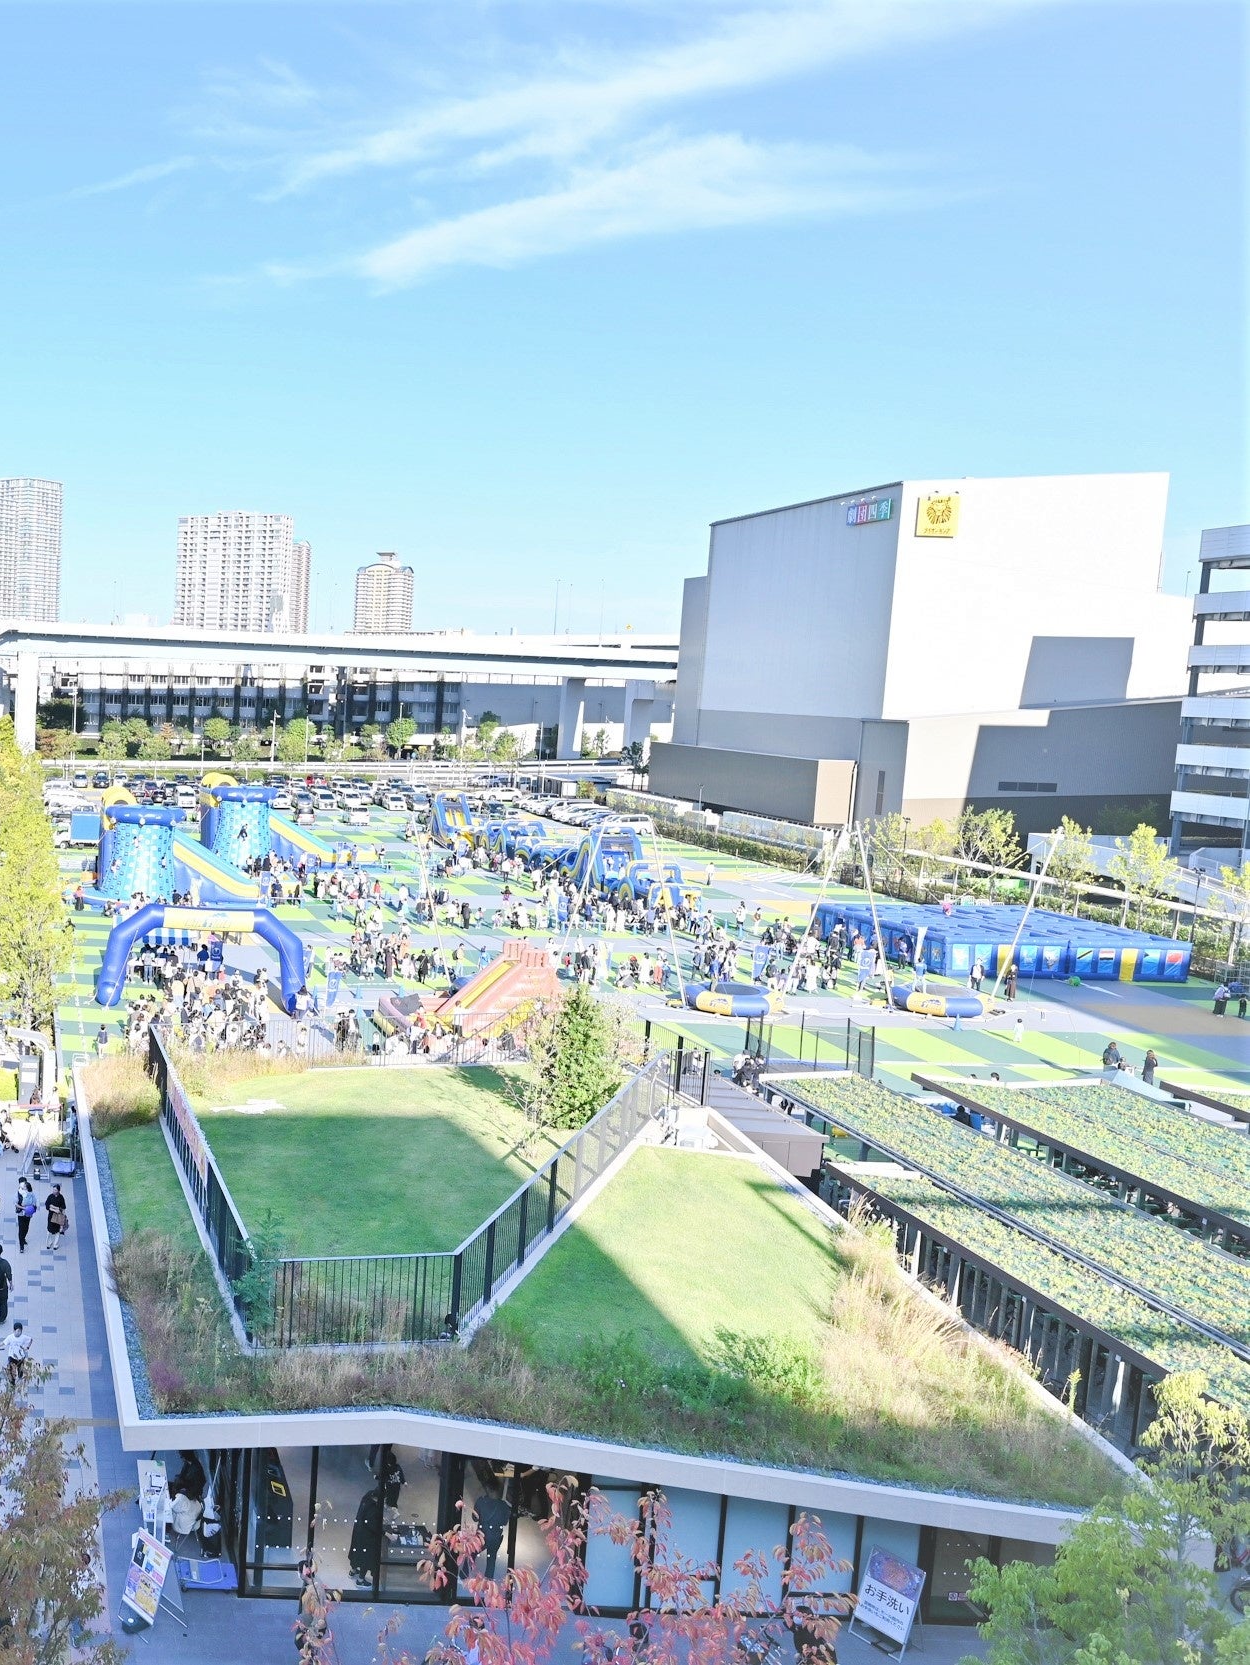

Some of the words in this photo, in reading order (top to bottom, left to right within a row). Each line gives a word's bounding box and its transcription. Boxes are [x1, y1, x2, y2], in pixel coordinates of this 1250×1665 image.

[848, 501, 888, 523] 劇団四季
[865, 1584, 909, 1615] お手洗い
